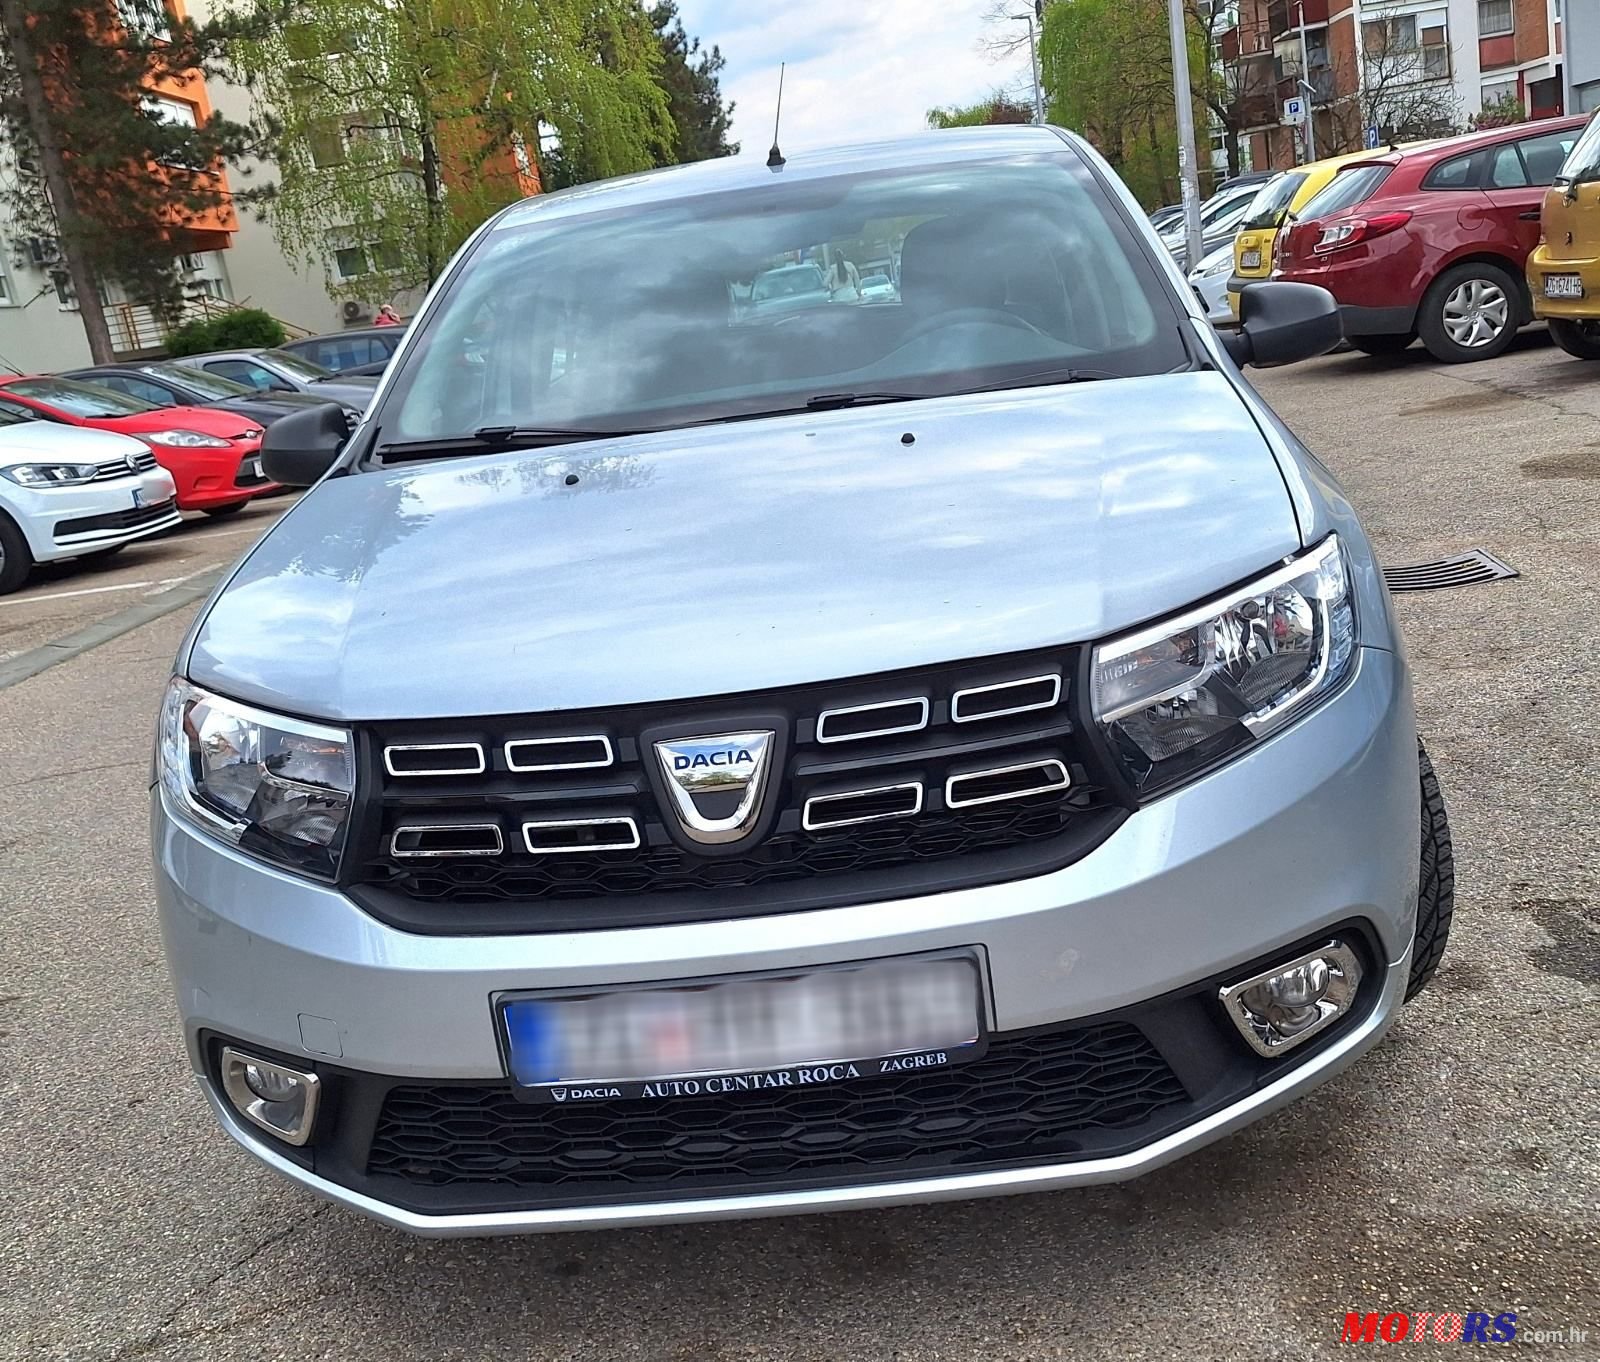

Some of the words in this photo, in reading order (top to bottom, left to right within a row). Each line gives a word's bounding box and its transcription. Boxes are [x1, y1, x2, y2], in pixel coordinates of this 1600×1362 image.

[674, 750, 754, 770] DACIA
[641, 1079, 700, 1099] AUTO
[705, 1071, 792, 1094] CENTAR
[796, 1062, 861, 1083] ROCA
[879, 1052, 947, 1074] ZAGREB
[570, 1086, 622, 1100] DACIA
